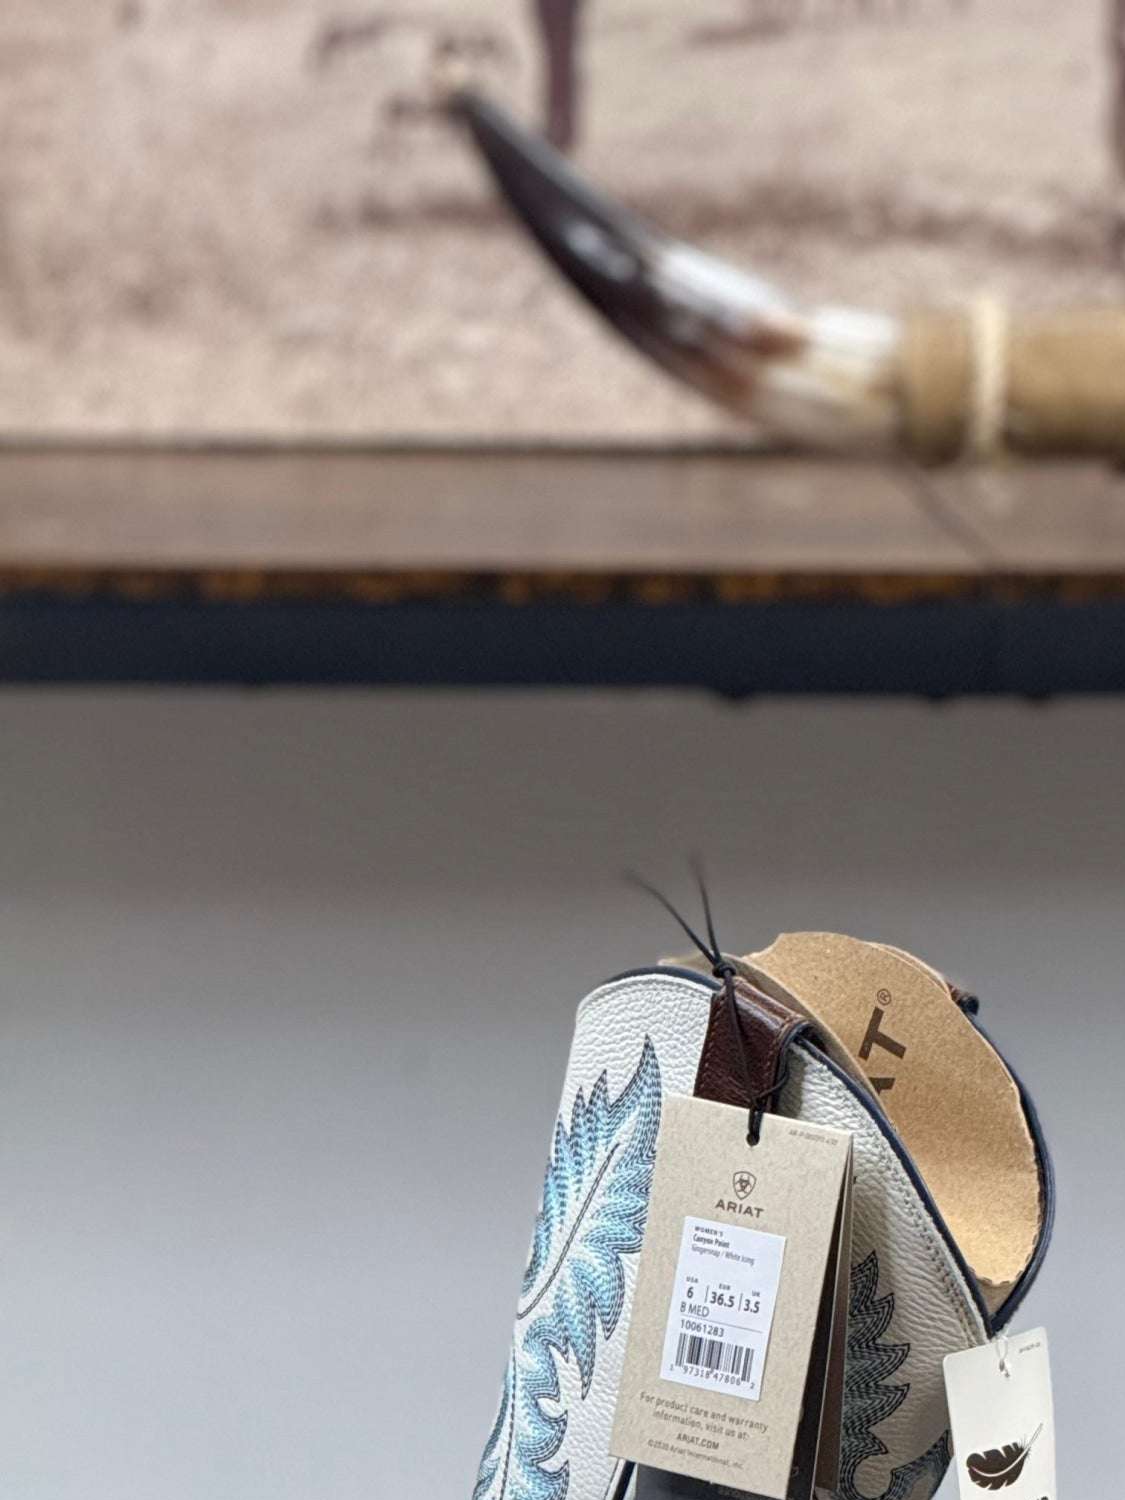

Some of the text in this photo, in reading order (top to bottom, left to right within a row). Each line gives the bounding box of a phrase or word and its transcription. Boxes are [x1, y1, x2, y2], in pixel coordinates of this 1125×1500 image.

[715, 1199, 765, 1218] ARIAT
[680, 1302, 710, 1318] B MED
[686, 1287, 761, 1314] 6 36.5 3.5
[680, 1319, 725, 1338] 10061283
[640, 1391, 769, 1434] For product care and warranty
[705, 1423, 724, 1435] visit
[725, 1430, 736, 1439] us
[676, 1432, 720, 1450] ARIAT.COM
